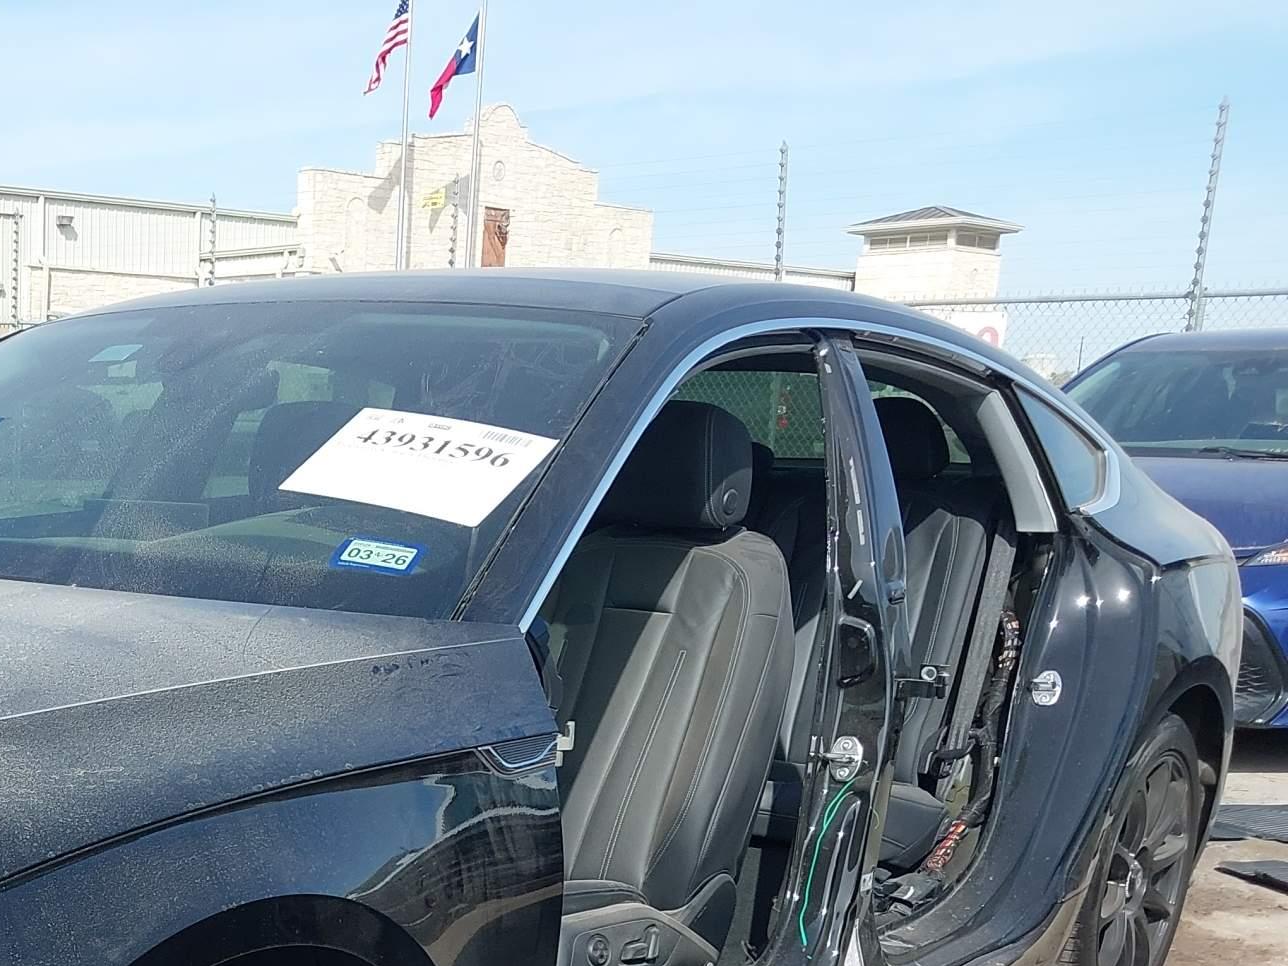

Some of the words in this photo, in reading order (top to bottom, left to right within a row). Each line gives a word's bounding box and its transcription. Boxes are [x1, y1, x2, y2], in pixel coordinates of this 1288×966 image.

[356, 428, 515, 468] 43931596
[347, 547, 374, 560] 03
[381, 553, 409, 566] 26
